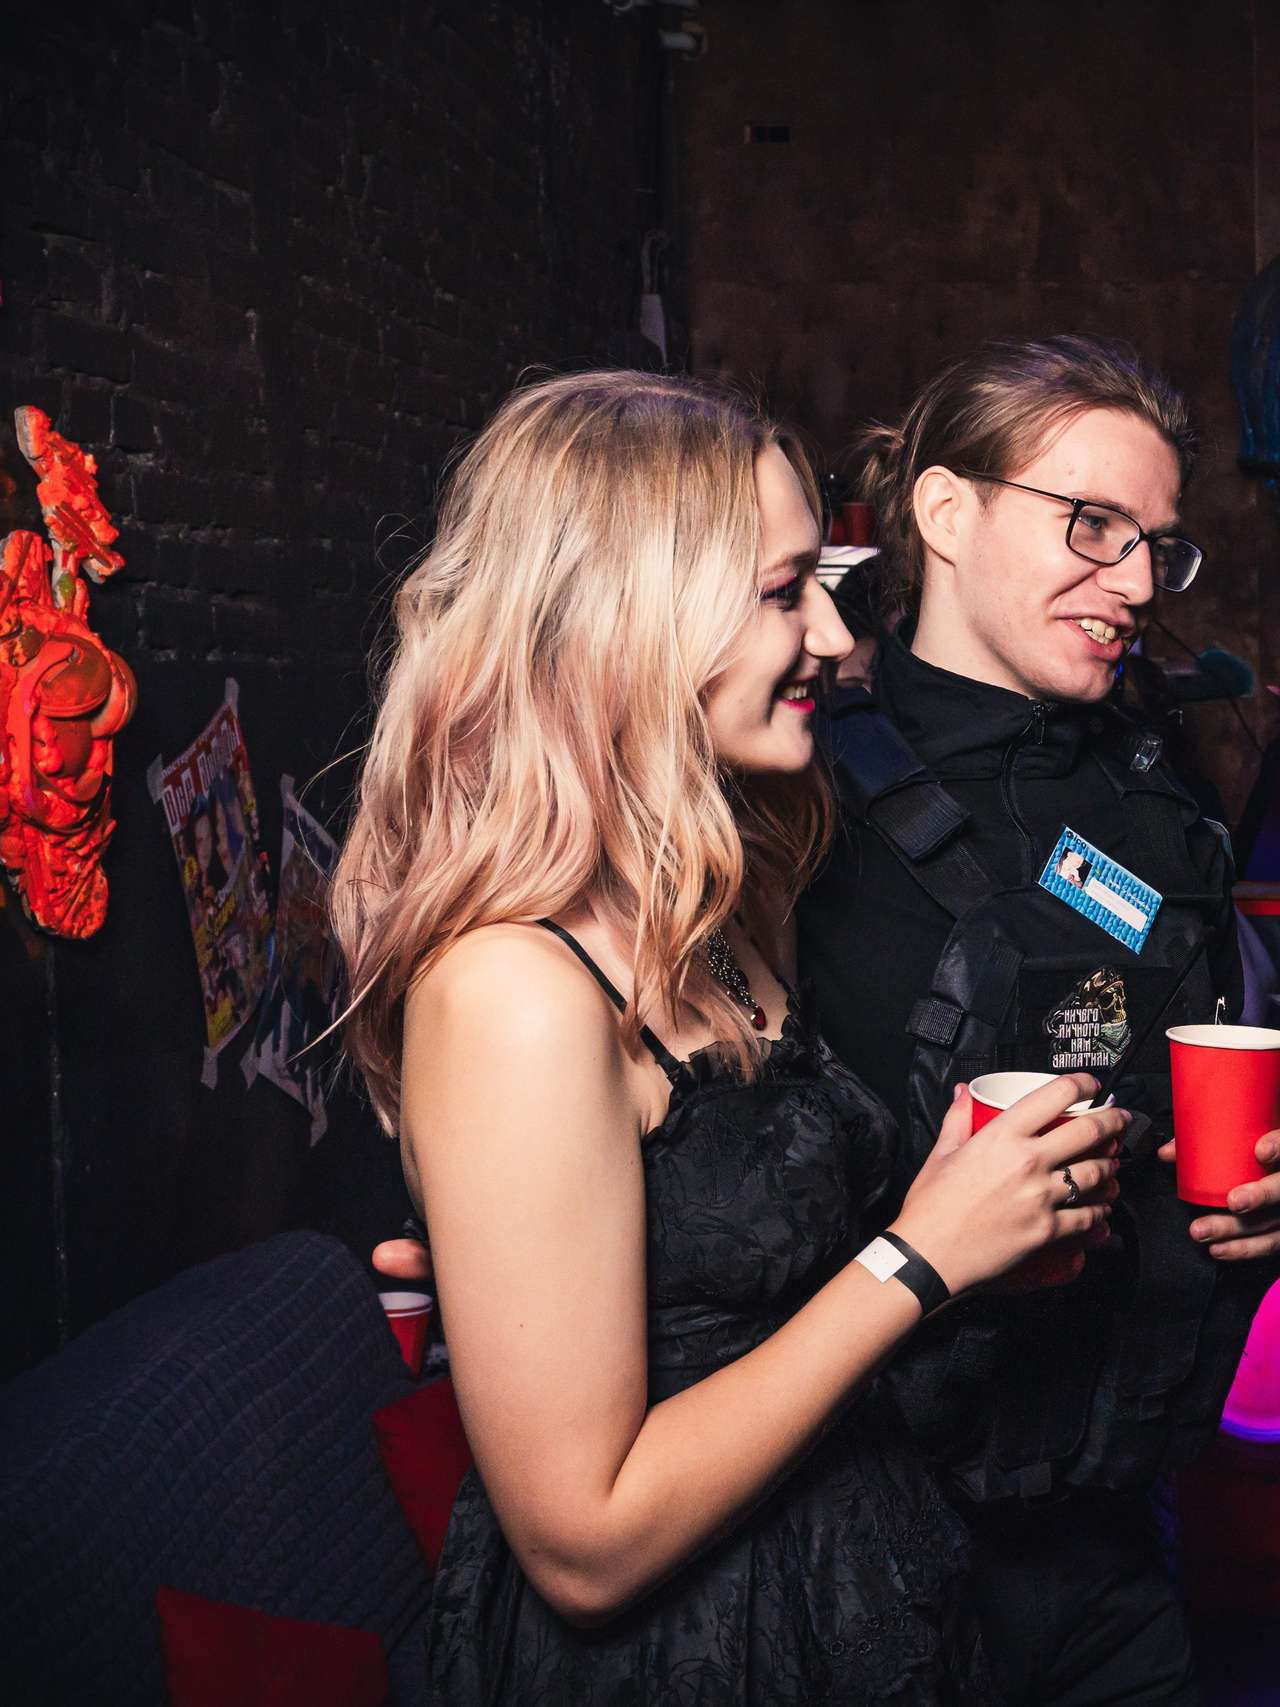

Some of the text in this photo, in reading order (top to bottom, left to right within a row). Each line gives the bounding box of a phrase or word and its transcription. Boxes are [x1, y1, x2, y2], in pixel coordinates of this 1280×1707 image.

[1073, 835, 1087, 850] icq
[1064, 1008, 1099, 1023] НИЧЕГО
[1056, 1023, 1100, 1038] ЛИЧНОГО
[1071, 1038, 1092, 1052] НАМ
[1052, 1052, 1109, 1068] ЗАПЛАТИЛИ
